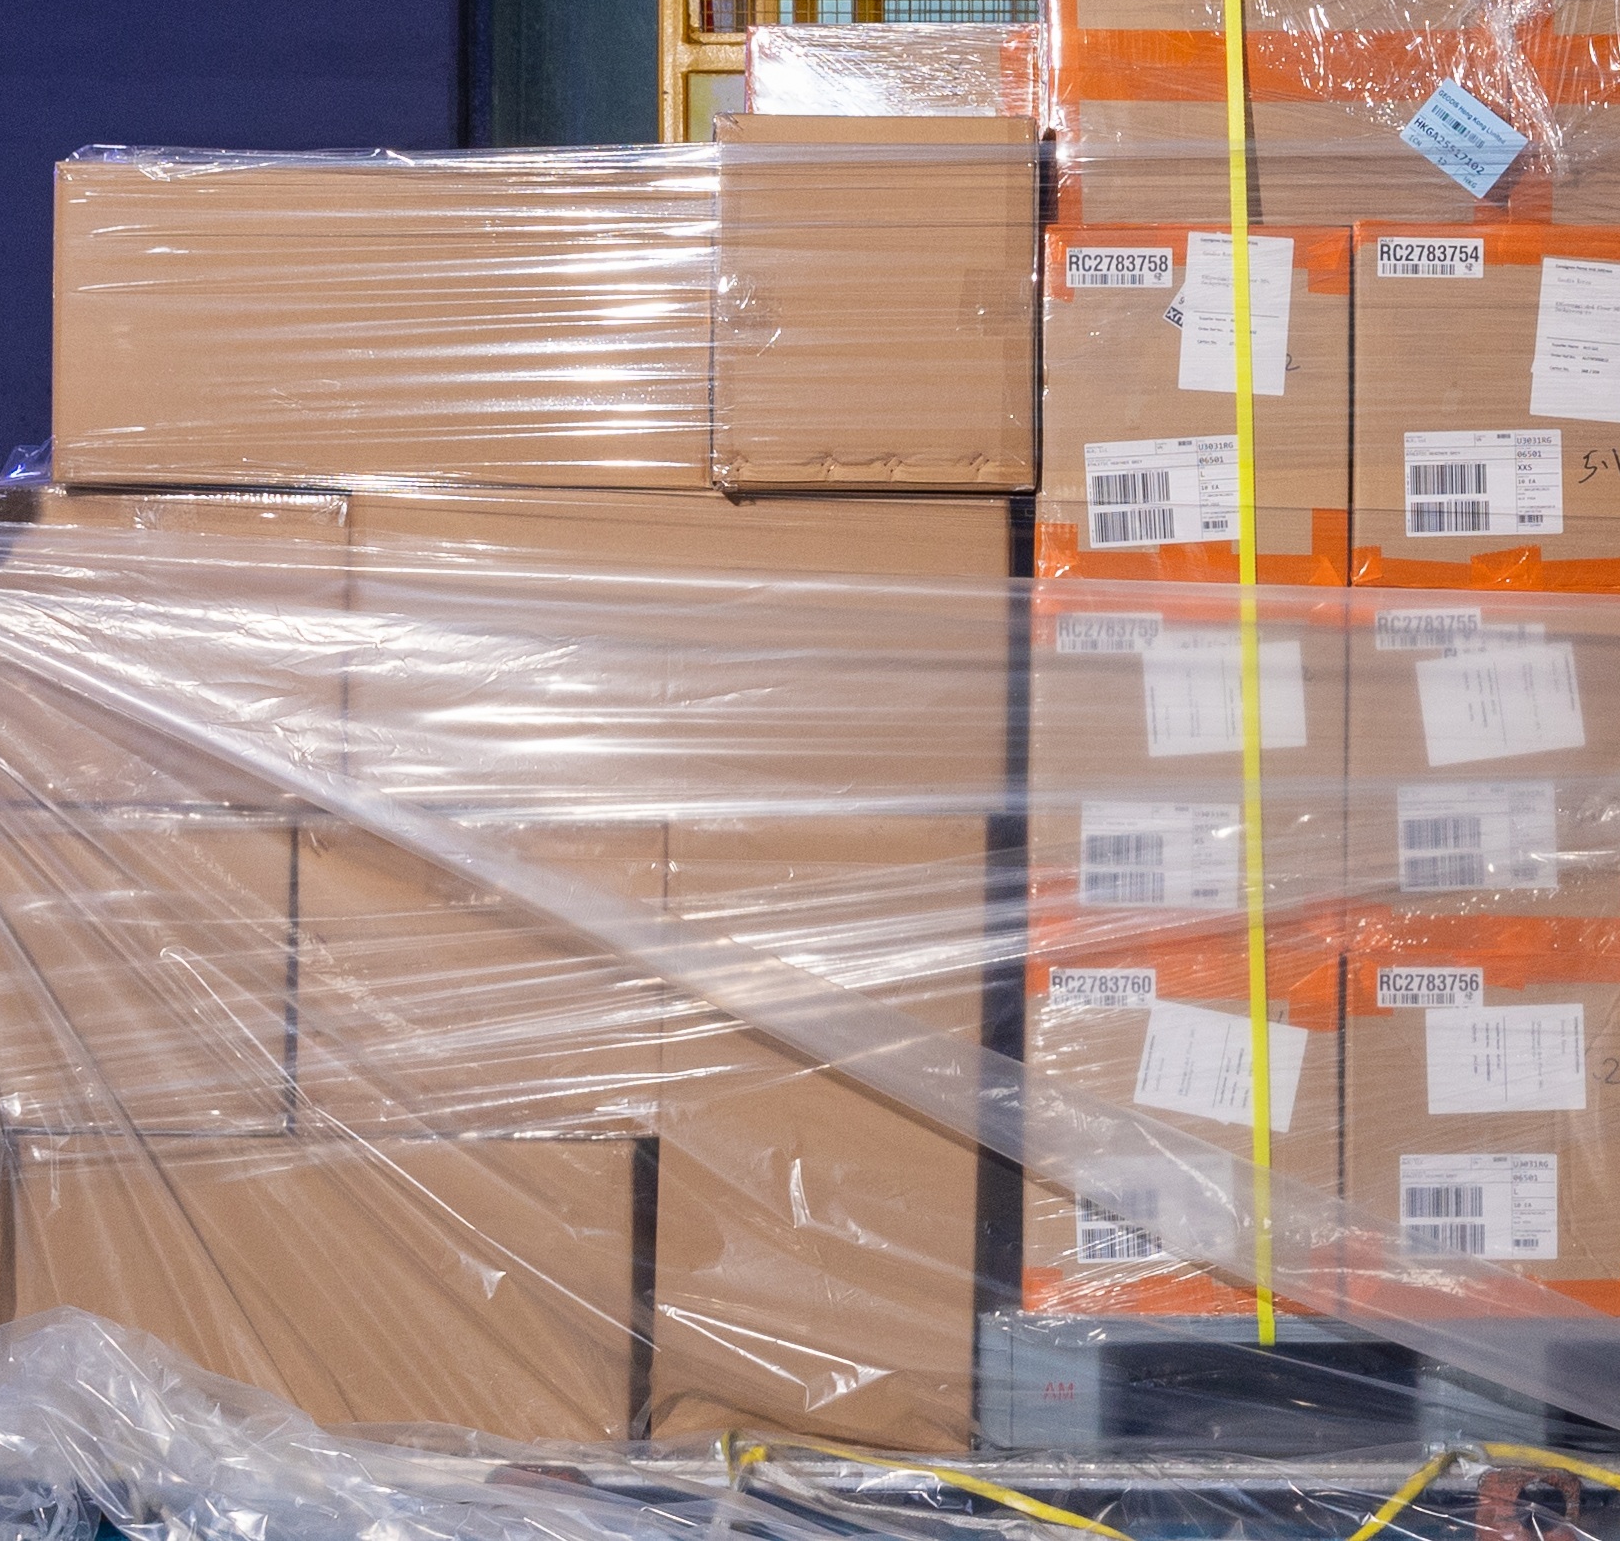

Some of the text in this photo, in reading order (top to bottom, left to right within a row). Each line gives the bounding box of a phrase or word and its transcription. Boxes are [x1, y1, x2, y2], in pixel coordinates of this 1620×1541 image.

[1413, 117, 1485, 176] HKGA25517102
[1068, 253, 1169, 273] RC2783758
[1379, 244, 1480, 263] RC2783754
[1198, 442, 1234, 452] U3031RG
[1516, 437, 1552, 445] U3031RG
[1199, 455, 1224, 465] 06501
[1517, 450, 1542, 458] 06501
[1517, 463, 1533, 471] XXS
[1058, 619, 1160, 638] RC2783759
[1377, 614, 1479, 635] RC2783755
[1052, 975, 1152, 994] RC2783760
[1379, 973, 1480, 992] RC2783756
[1513, 1174, 1538, 1182] 06501
